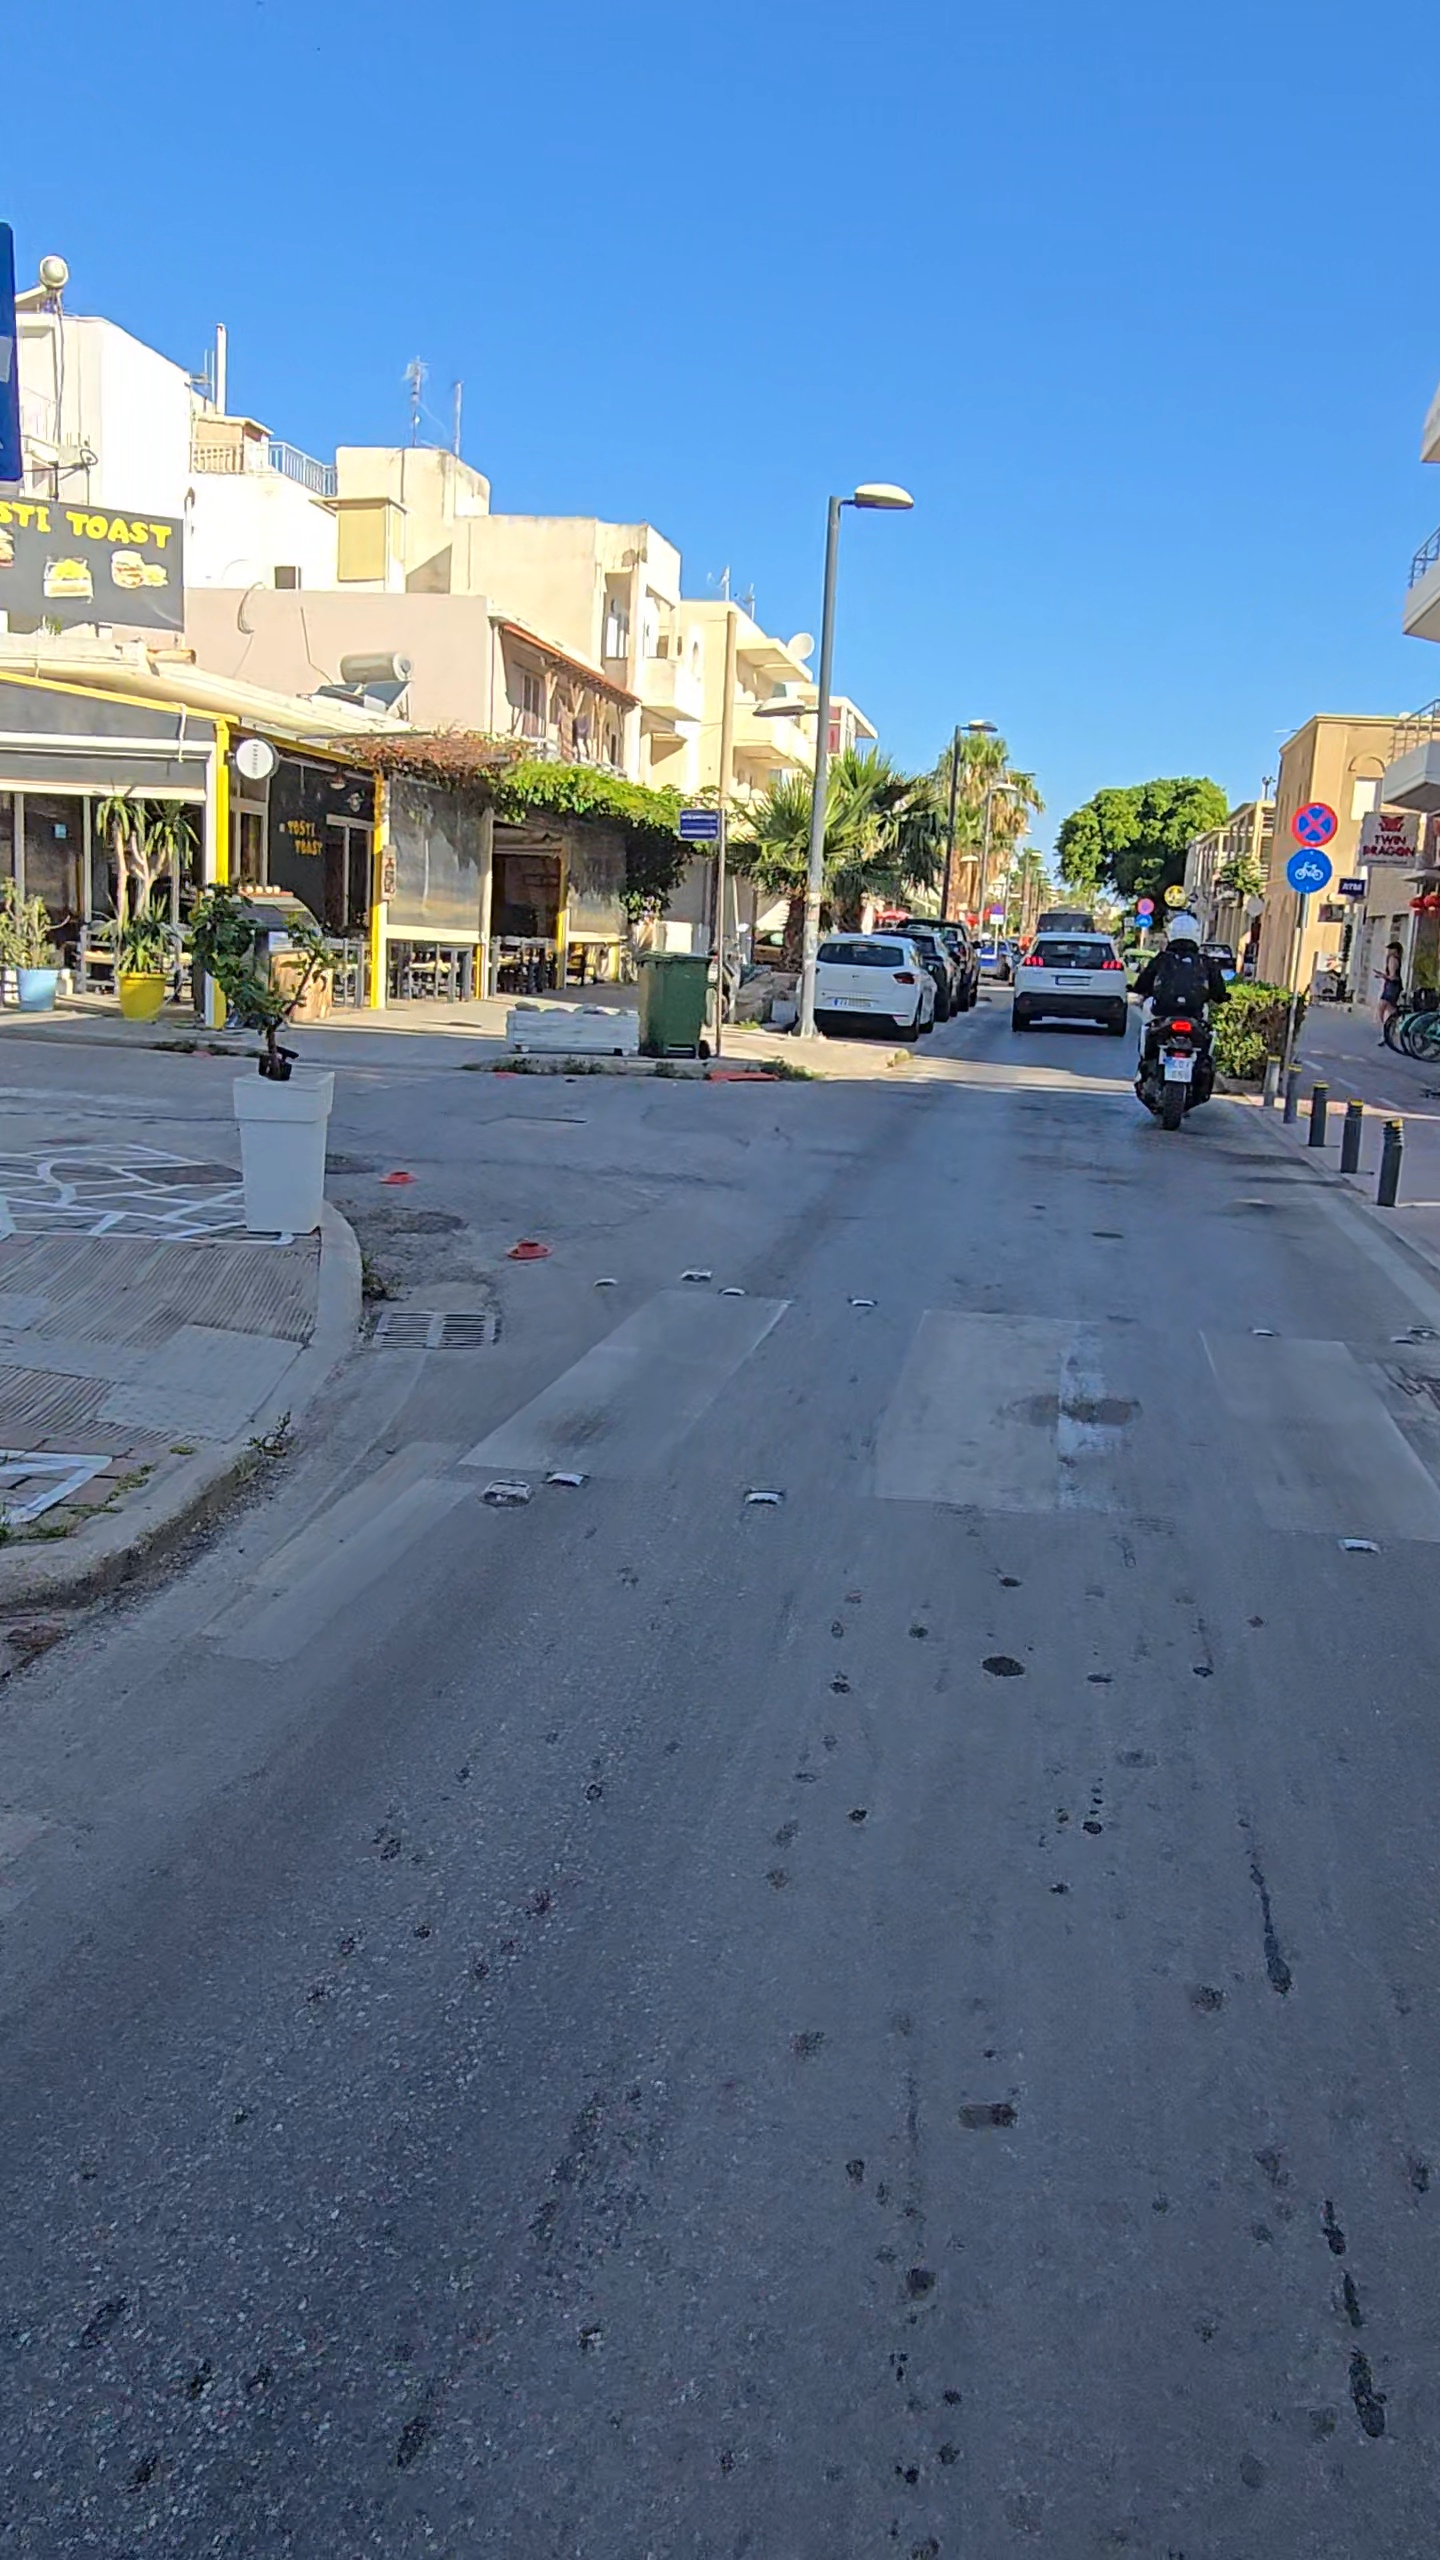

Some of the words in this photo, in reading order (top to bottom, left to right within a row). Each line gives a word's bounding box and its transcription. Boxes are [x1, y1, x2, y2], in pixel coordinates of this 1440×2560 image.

[65, 510, 173, 549] TOAST
[1375, 834, 1407, 845] TWIN
[1363, 845, 1416, 857] DRAGON
